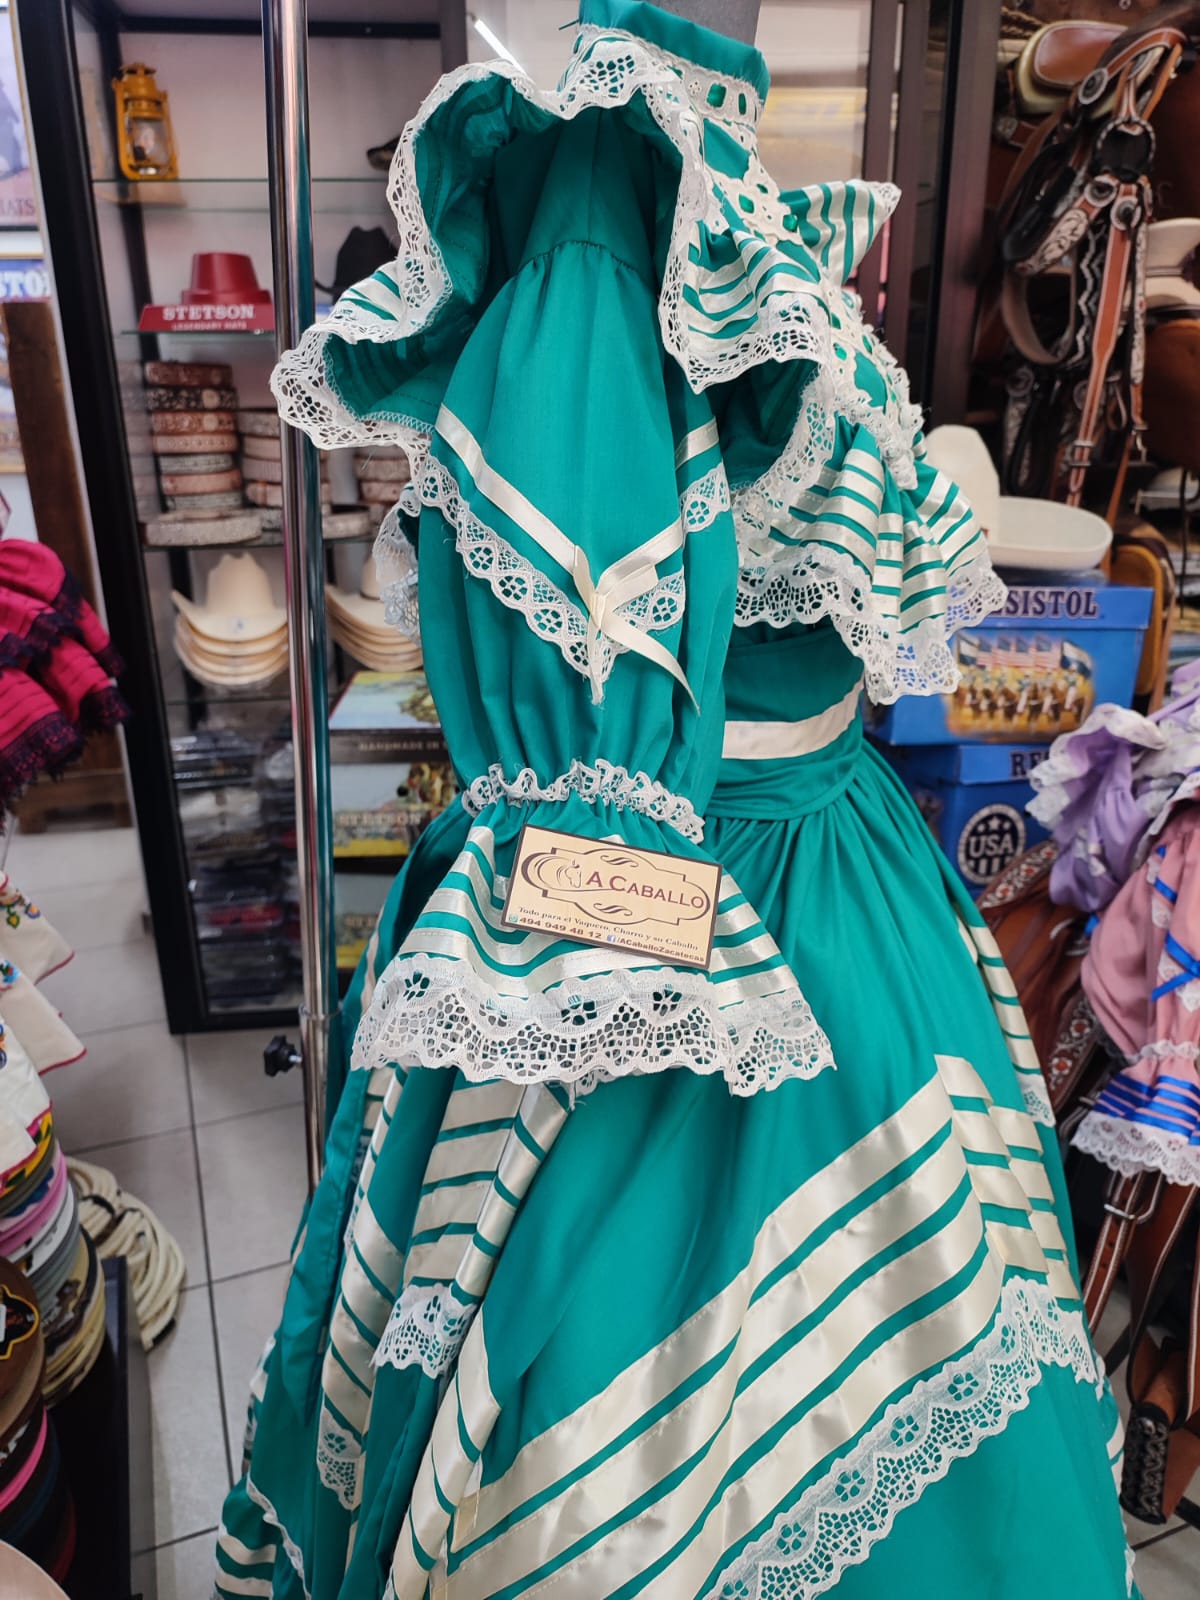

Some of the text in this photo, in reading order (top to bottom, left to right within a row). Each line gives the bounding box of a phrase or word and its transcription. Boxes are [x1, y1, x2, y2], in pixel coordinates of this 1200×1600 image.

[162, 304, 255, 320] STETSON
[991, 590, 1097, 616] SISTOL
[358, 740, 423, 751] HANDMADE
[968, 833, 1014, 858] USA
[586, 871, 705, 908] A CABALLO
[520, 917, 541, 927] 494
[545, 922, 566, 931] 949
[569, 927, 584, 936] 48
[589, 931, 602, 939] 12
[520, 907, 539, 916] Todo
[541, 912, 561, 921] para
[613, 926, 643, 938] Charro
[665, 938, 698, 951] Caballo
